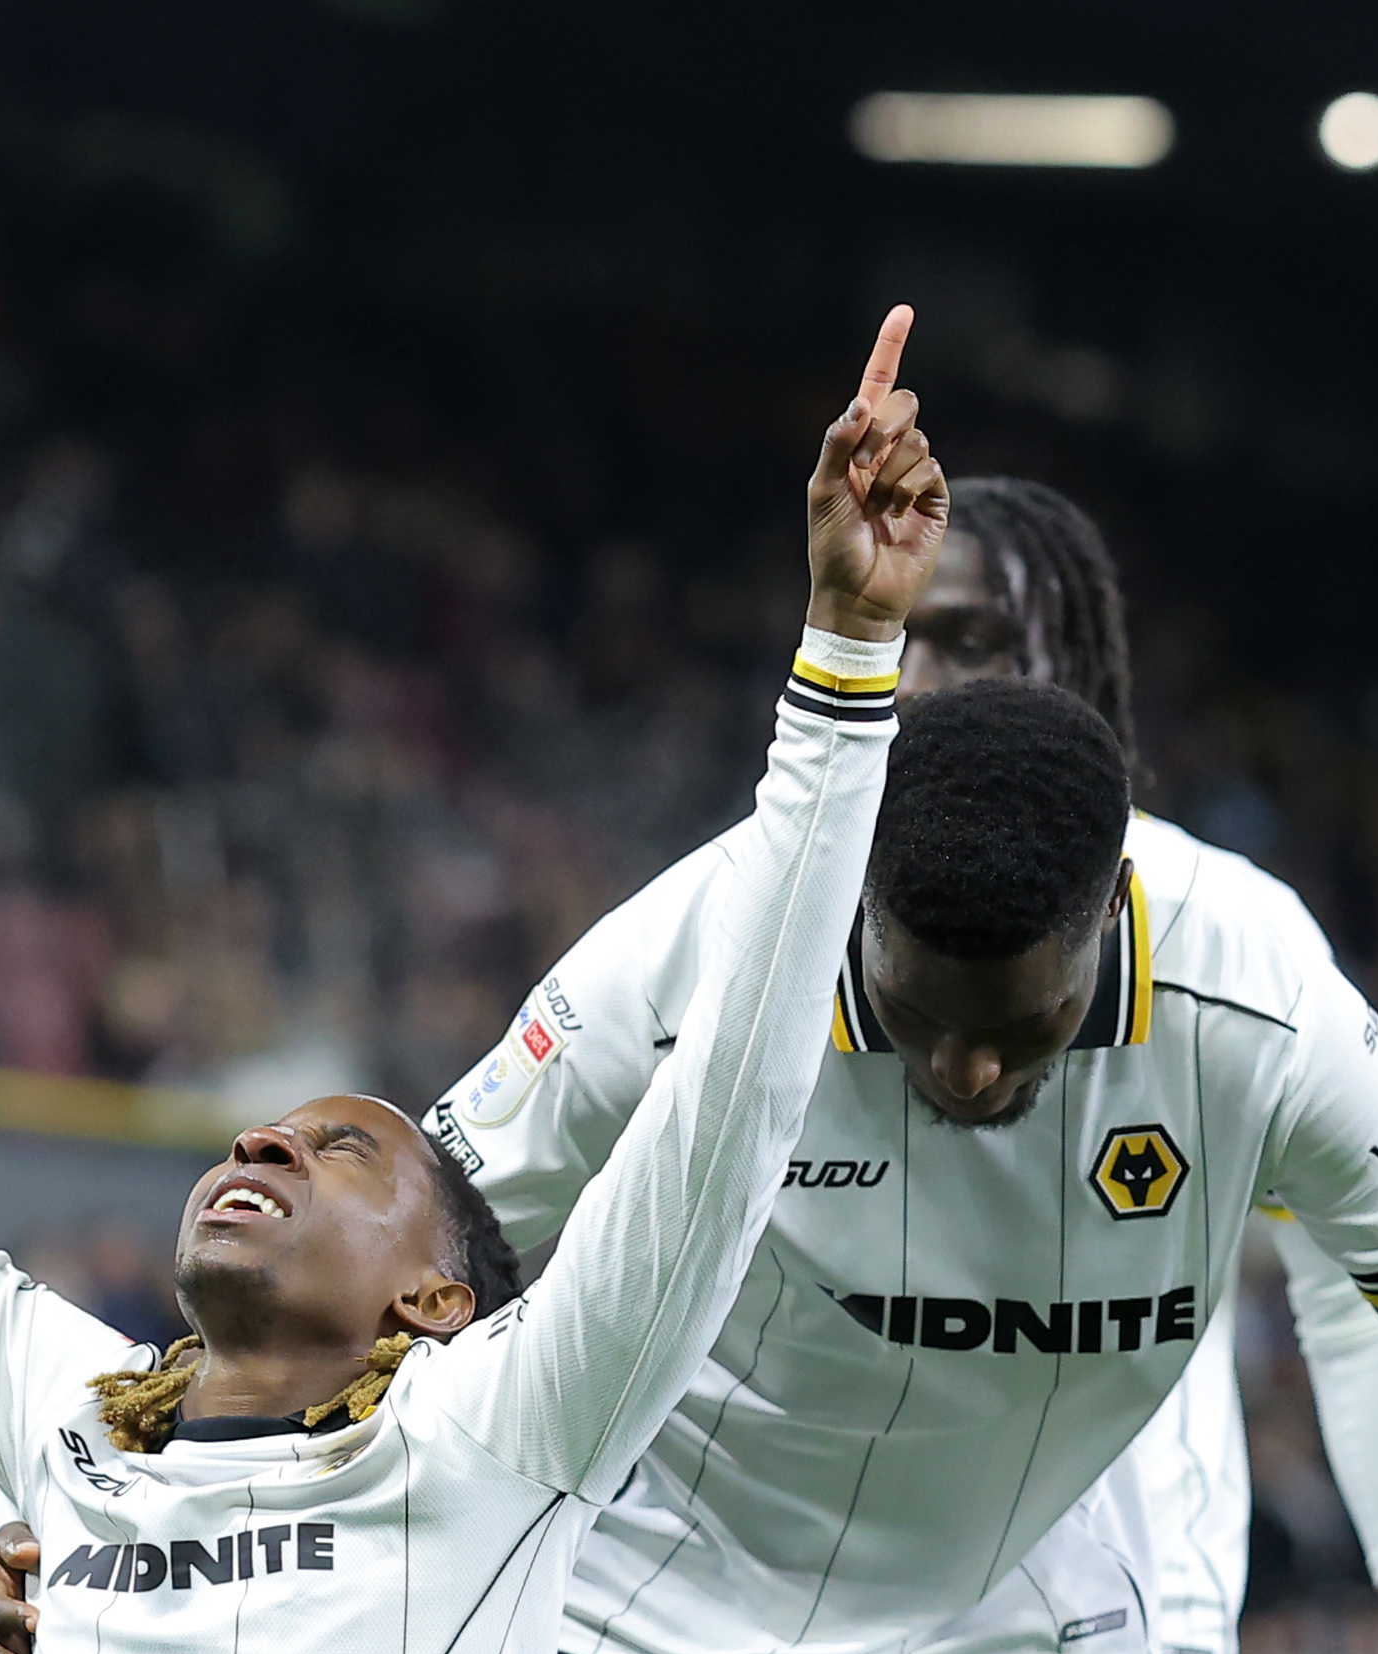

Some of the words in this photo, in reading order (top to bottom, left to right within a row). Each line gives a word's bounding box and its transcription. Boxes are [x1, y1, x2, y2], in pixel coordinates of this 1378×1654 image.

[544, 977, 584, 1032] SUDU
[525, 1023, 550, 1057] bet
[58, 1427, 142, 1497] SUDU
[47, 1522, 334, 1593] MIDNITE
